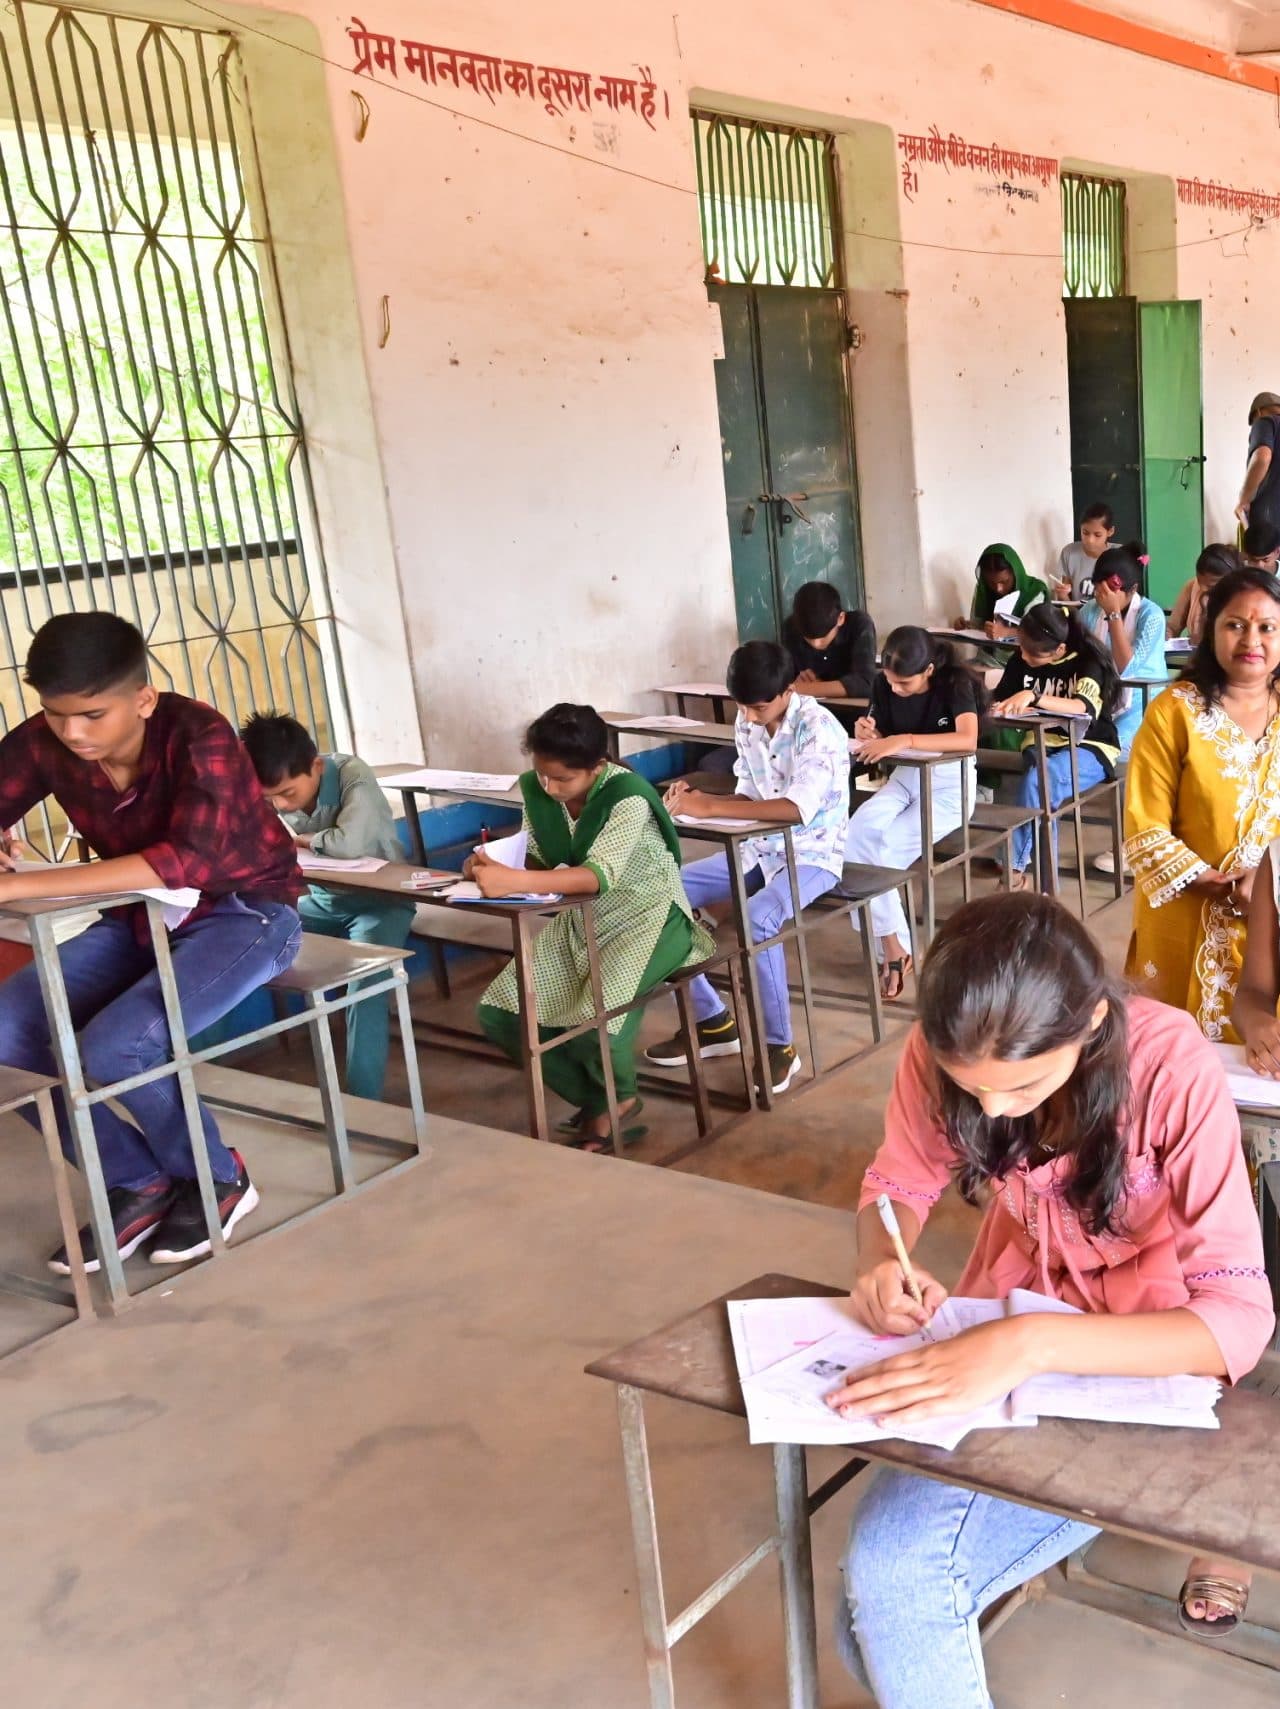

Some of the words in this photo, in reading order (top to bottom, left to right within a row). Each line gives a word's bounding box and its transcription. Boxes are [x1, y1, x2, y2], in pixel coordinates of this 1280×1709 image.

[349, 17, 397, 79] प्रेम
[400, 40, 502, 106] मानवता
[504, 60, 535, 100] का
[537, 66, 592, 116] दूसरा
[594, 75, 638, 116] नाम
[898, 133, 926, 168] नम्रता
[927, 124, 950, 174] और
[948, 133, 967, 167] मीठे
[967, 145, 989, 173] वचन
[990, 143, 1001, 178] ही
